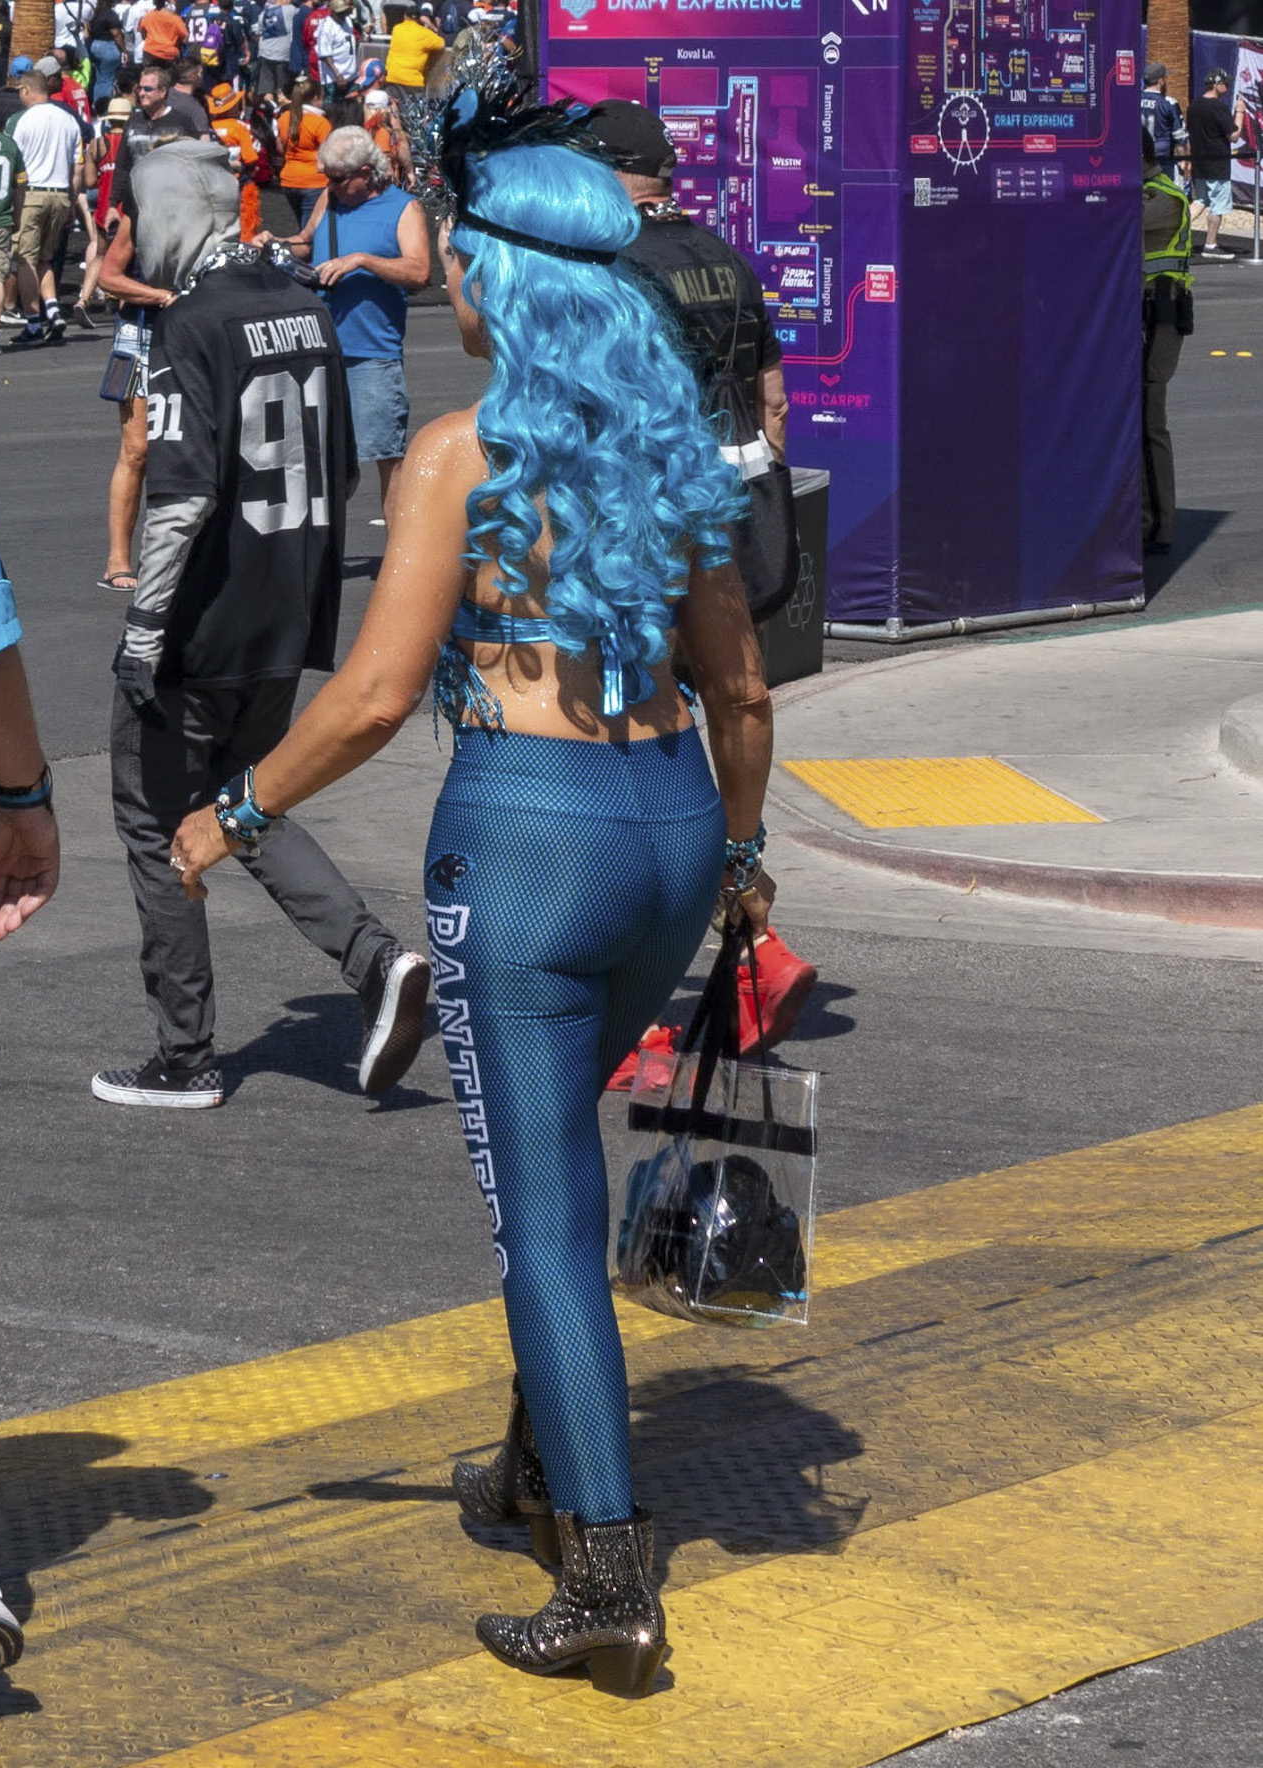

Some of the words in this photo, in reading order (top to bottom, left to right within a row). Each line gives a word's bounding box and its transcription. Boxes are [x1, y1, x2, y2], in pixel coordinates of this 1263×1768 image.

[187, 17, 207, 42] 13
[677, 49, 700, 59] Koval
[702, 49, 716, 59] Ln.
[1088, 43, 1096, 90] Flamingo
[823, 84, 833, 132] Flamingo
[994, 115, 1020, 127] DRAFT
[1023, 114, 1074, 127] EXPERIENCE
[772, 156, 801, 167] WESTIN
[823, 134, 833, 152] Rd.
[670, 267, 737, 304] WALLER
[822, 257, 833, 306] Flamingo
[823, 309, 833, 325] Rd.
[244, 315, 327, 357] DEADPOOL
[147, 393, 183, 441] 91
[792, 392, 816, 404] RED
[821, 393, 870, 407] CARPET
[240, 366, 330, 534] 91
[427, 899, 508, 1279] PANTHE
